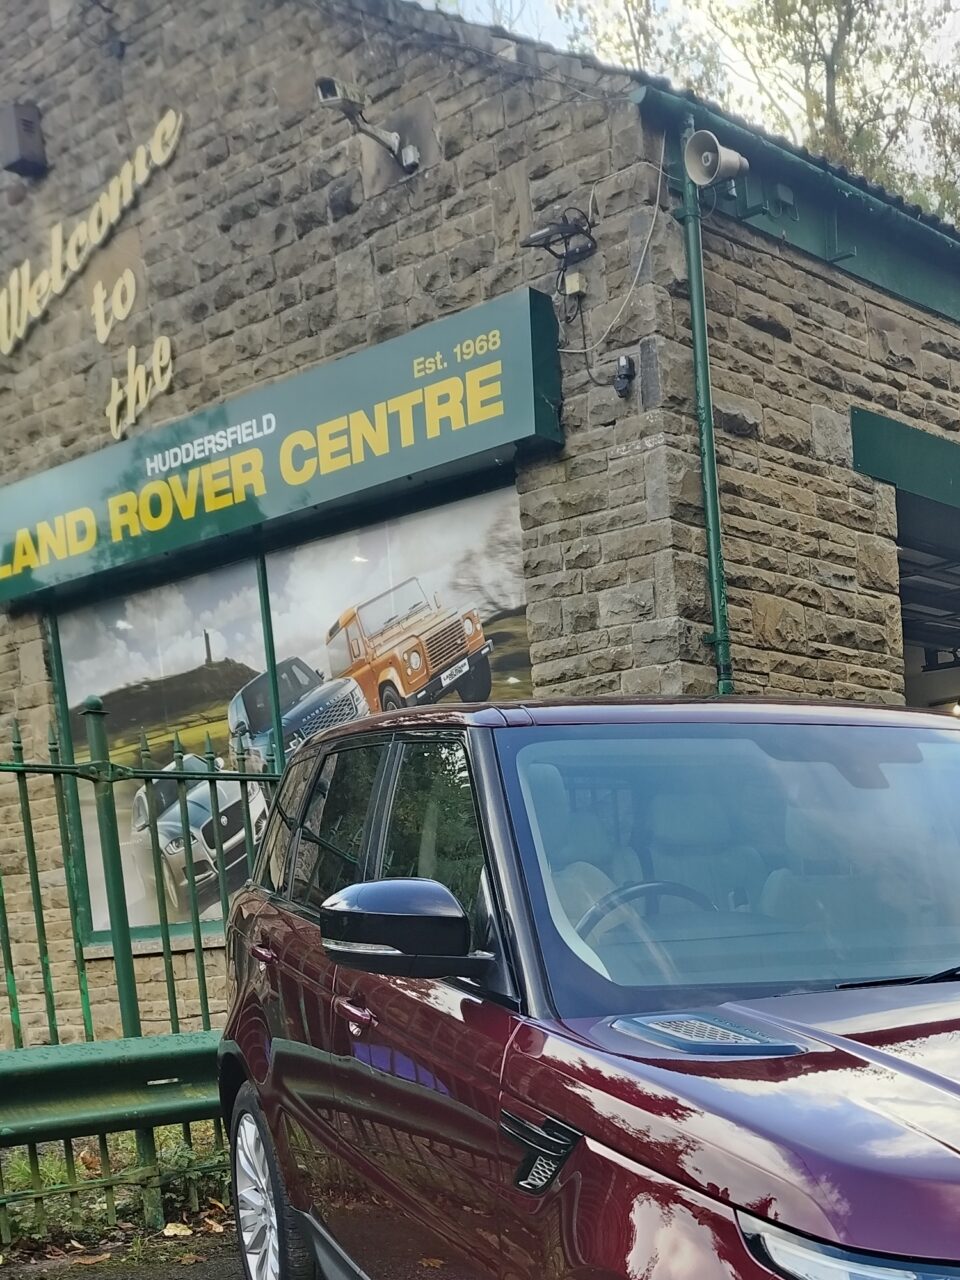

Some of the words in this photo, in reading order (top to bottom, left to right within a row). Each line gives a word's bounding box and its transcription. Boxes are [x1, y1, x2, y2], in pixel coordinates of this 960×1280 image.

[0, 108, 183, 355] Welcome
[91, 268, 136, 344] to
[106, 336, 173, 440] the
[413, 351, 448, 379] Est.
[453, 329, 501, 363] 1968
[107, 447, 268, 543] ROVER
[279, 359, 505, 487] CENTRE
[146, 412, 277, 477] HUDDERSFIELD
